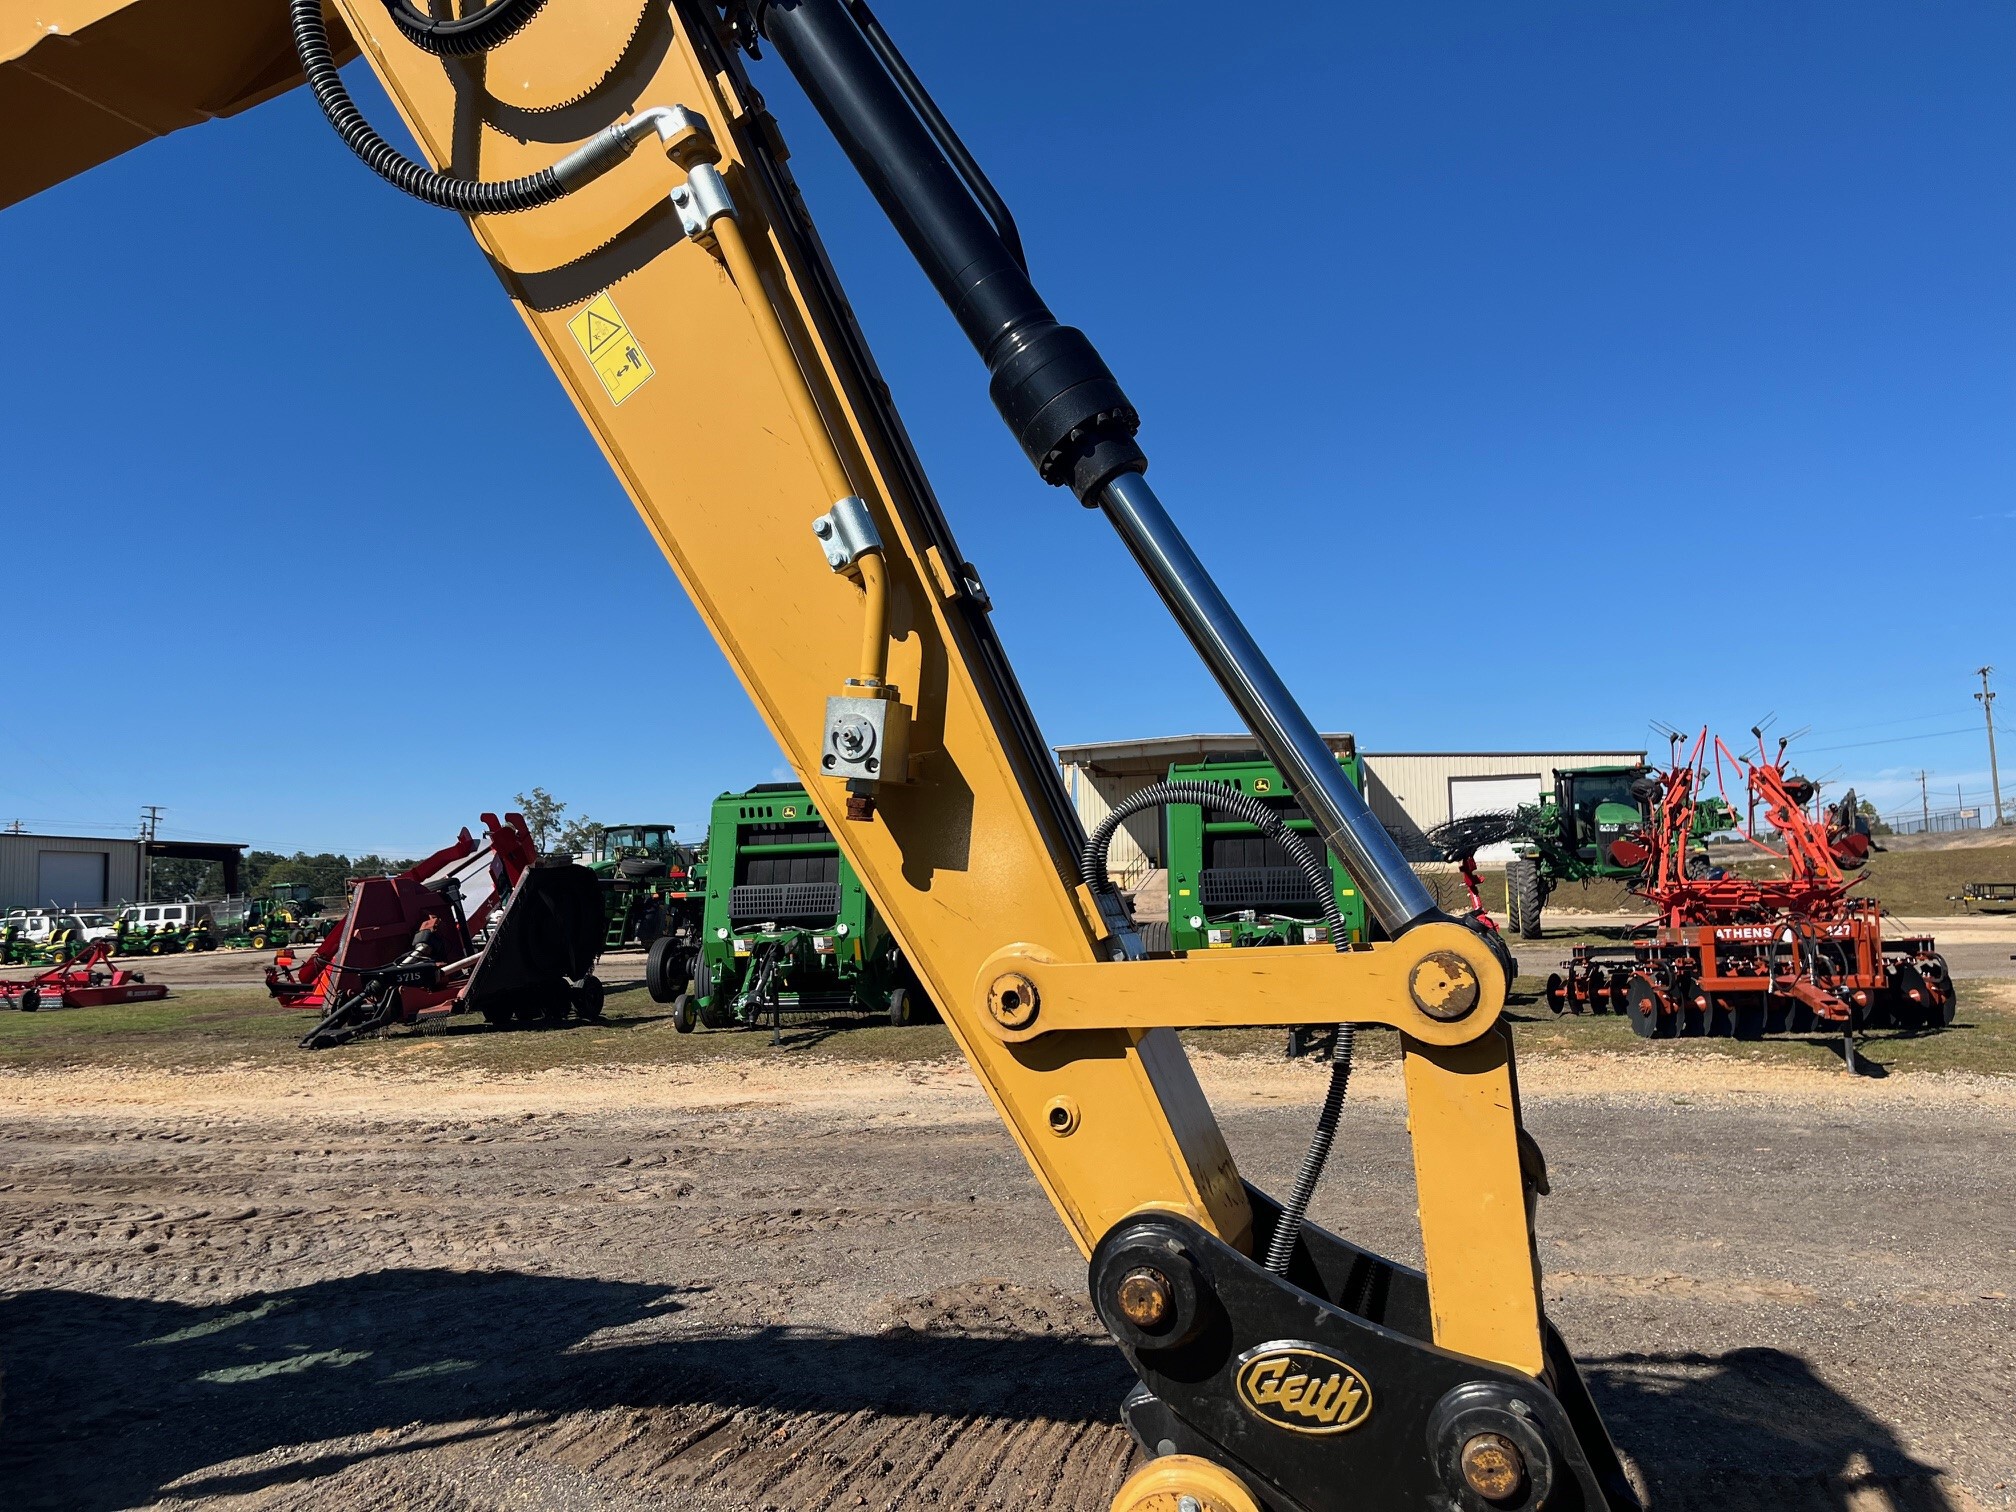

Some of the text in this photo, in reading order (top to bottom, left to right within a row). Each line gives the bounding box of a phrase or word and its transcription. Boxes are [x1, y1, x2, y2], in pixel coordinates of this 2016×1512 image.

[1716, 924, 1851, 939] ATHENS 127
[396, 972, 421, 982] 3715
[1246, 1357, 1363, 1423] Geith
